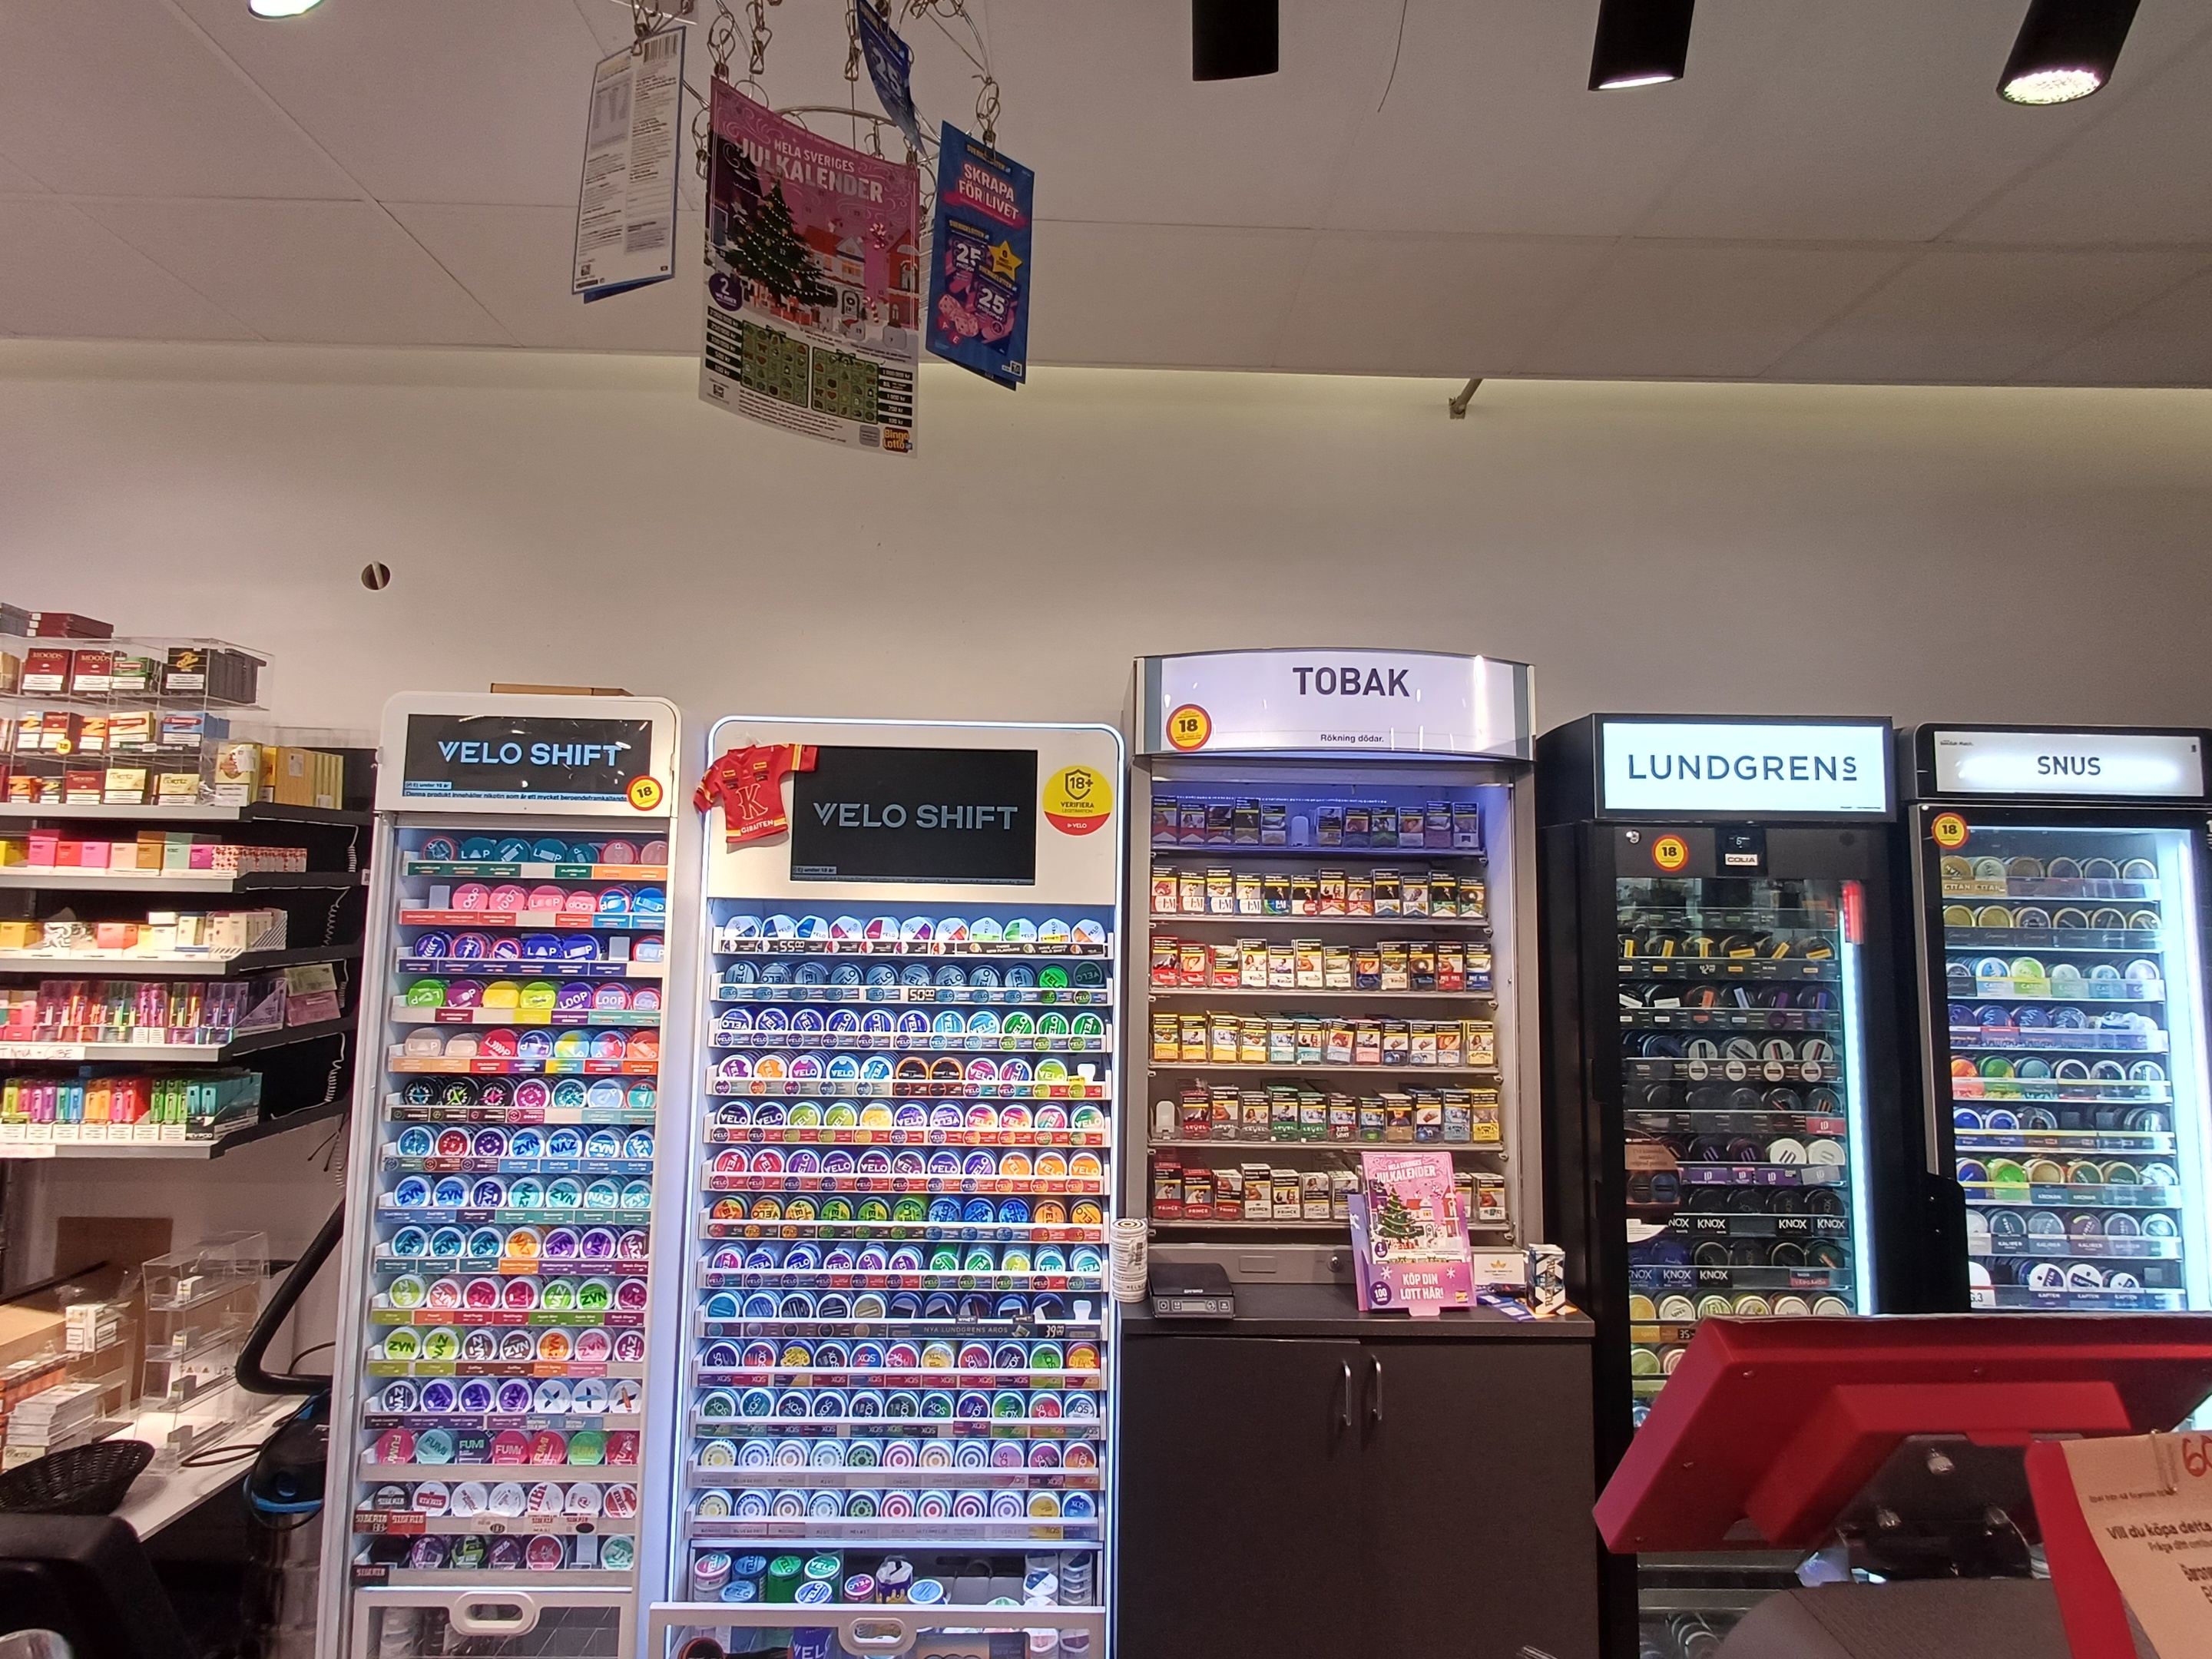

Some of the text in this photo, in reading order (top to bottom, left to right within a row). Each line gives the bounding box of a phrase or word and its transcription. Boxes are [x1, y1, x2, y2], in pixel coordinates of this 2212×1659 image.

[774, 140, 855, 172] HELA SVERIGES
[740, 137, 883, 204] JULKALENDER
[964, 164, 1014, 202] SKRAPA
[959, 180, 1018, 220] FÖR LIVET
[720, 277, 730, 294] 2
[979, 288, 1005, 314] 25
[883, 429, 910, 442] Bingo
[883, 439, 905, 449] Lotto
[1292, 667, 1410, 697] TOBAK
[1179, 719, 1198, 733] 18
[1320, 733, 1384, 744] Rökning dödar.
[438, 741, 623, 767] VELO SHIFT
[1628, 753, 1858, 783] LUNDGRENS
[2037, 756, 2101, 777] SNUS
[1069, 777, 1093, 789] 18+
[637, 786, 652, 799] 18
[736, 783, 768, 820] K
[813, 802, 1018, 830] VELO SHIFT
[1942, 824, 1958, 835] 18
[1661, 846, 1677, 856] 18
[559, 992, 588, 1009] LOOP
[596, 997, 624, 1005] LOOP
[793, 1068, 817, 1077] VELO
[721, 1114, 747, 1124] VELO
[757, 1113, 783, 1124] VELO
[1075, 1118, 1101, 1128] VELO
[514, 1138, 540, 1154] ZYN
[588, 1144, 614, 1152] ZYN
[861, 1164, 888, 1173] VELO
[931, 1164, 958, 1173] VELO
[1072, 1165, 1099, 1175] VELO
[1399, 1159, 1422, 1169] SVERIGES
[1376, 1165, 1436, 1184] JULKALENDER
[438, 1190, 463, 1200] ZYN
[550, 1189, 576, 1205] ZYN
[1697, 1218, 1726, 1229] KNOX
[1779, 1219, 1806, 1229] KNOX
[1817, 1218, 1845, 1229] KNOX
[1402, 1272, 1438, 1285] KÖP DIN
[1663, 1270, 1691, 1280] KNOX
[1700, 1270, 1728, 1280] KNOX
[581, 1292, 607, 1304] ZYN
[1374, 1289, 1387, 1298] 100
[1400, 1286, 1443, 1300] LOTT HÄR!
[389, 1341, 416, 1353] ZYN
[504, 1341, 529, 1356] ZYN
[710, 1399, 729, 1416] XQS
[786, 1399, 803, 1416] XQS
[929, 1401, 946, 1415] XQS
[426, 1436, 448, 1456] FUMI
[459, 1439, 485, 1449] FUMI
[495, 1444, 523, 1455] FUMI
[1071, 1501, 1084, 1509] XQS
[2107, 1520, 2212, 1539] Vill du köpa detta
